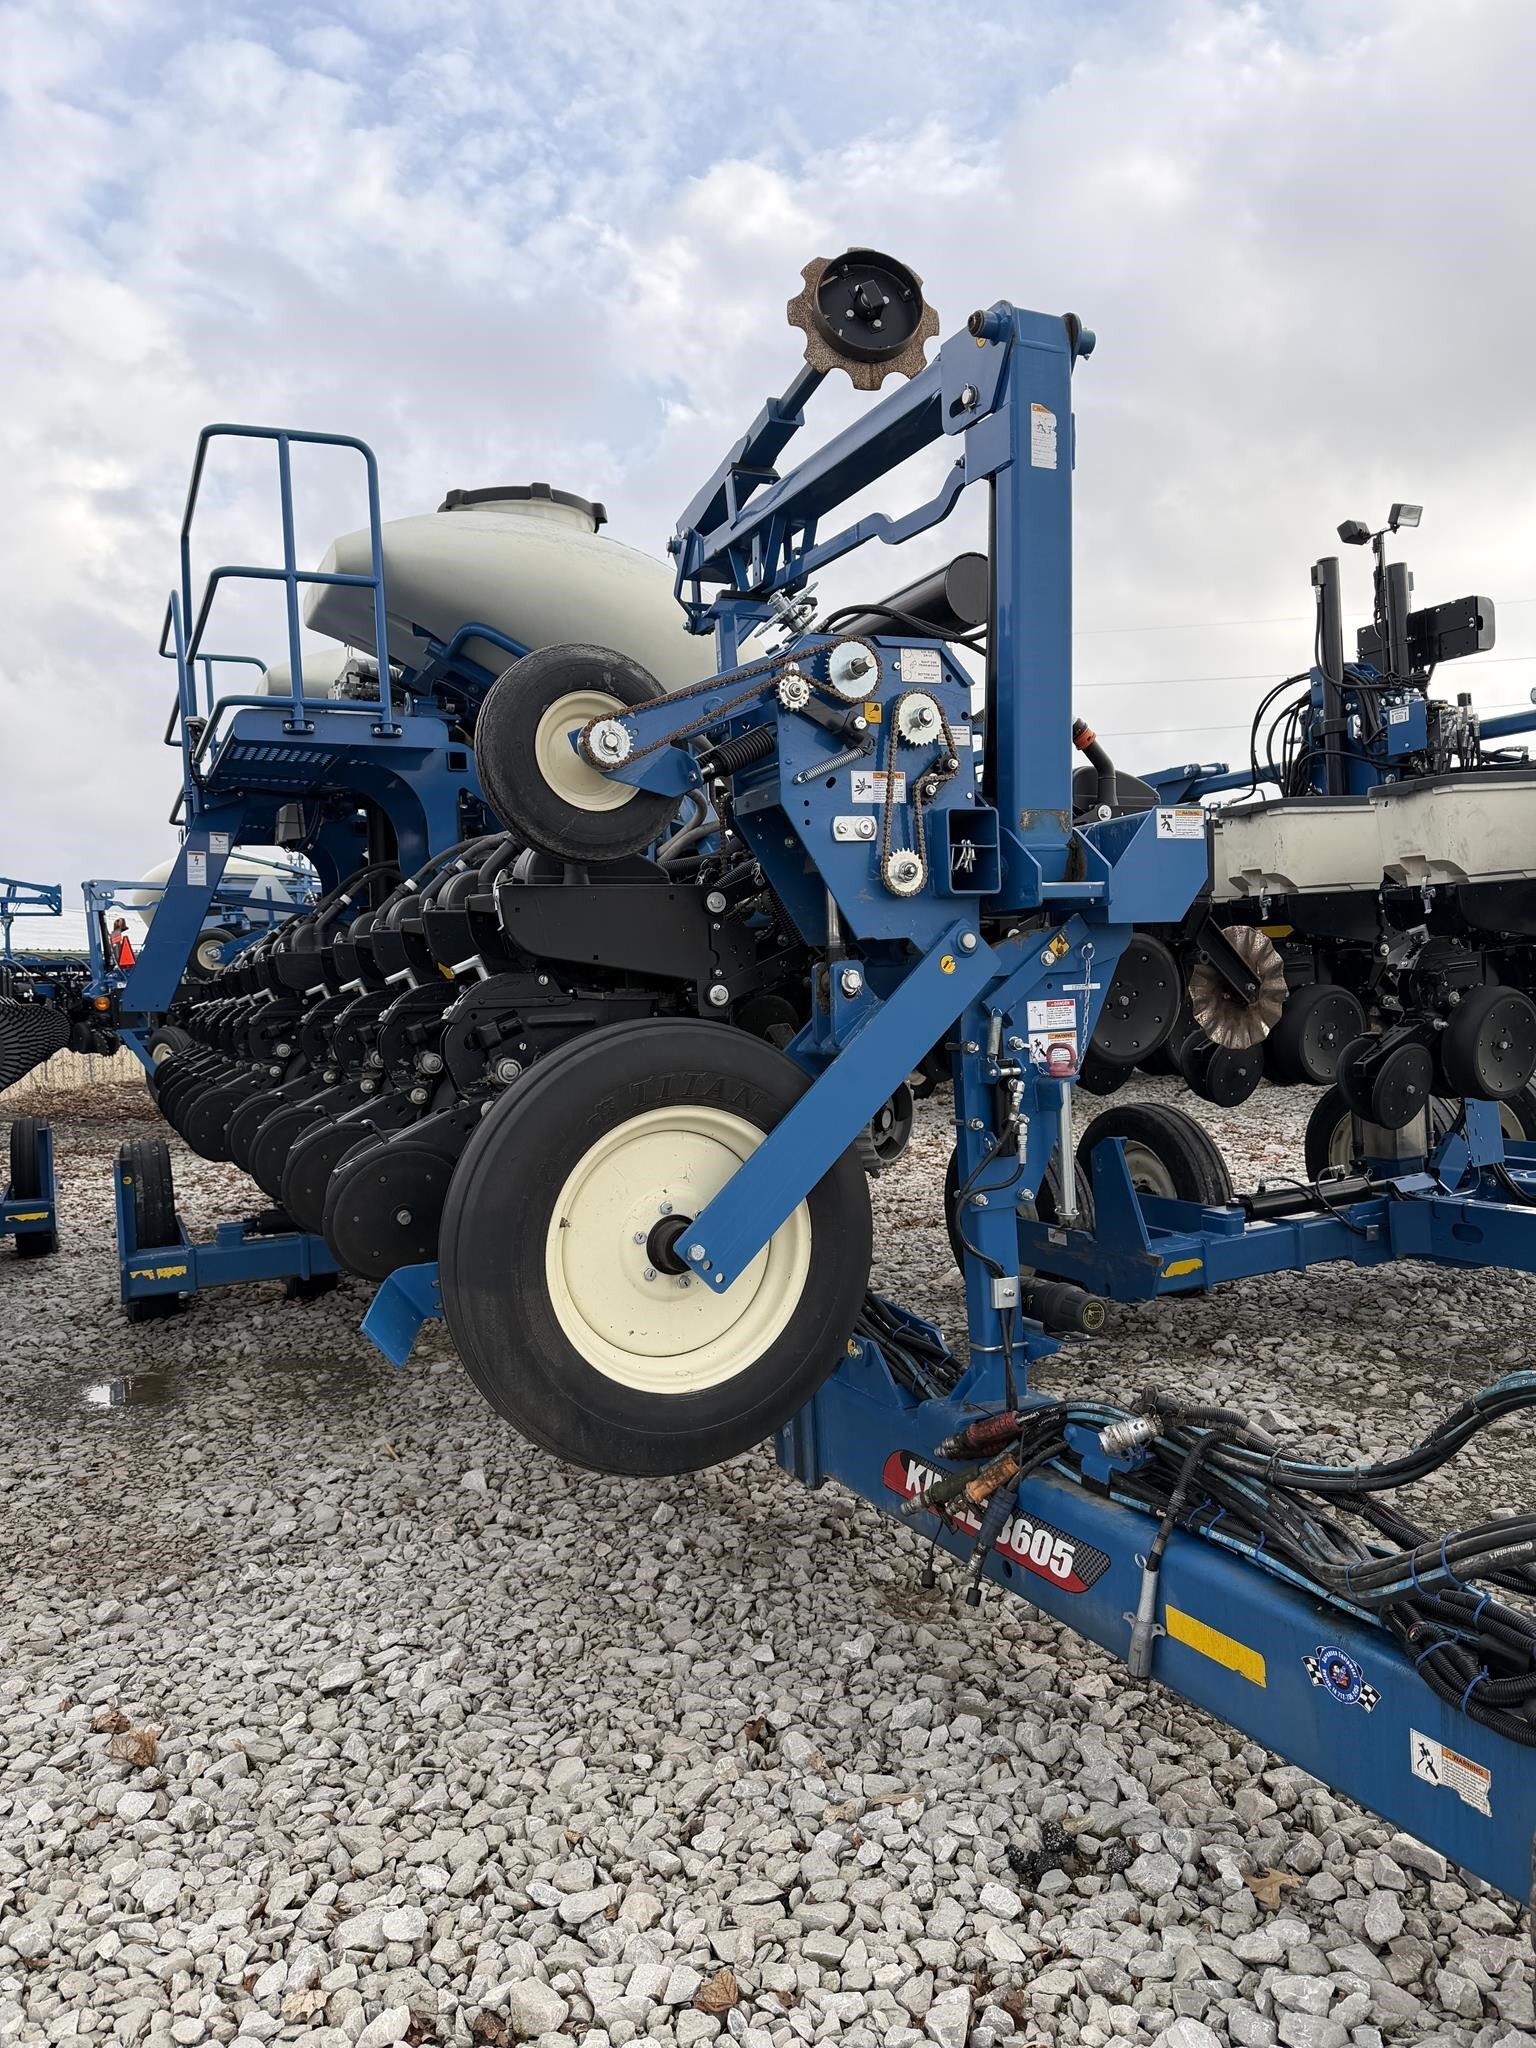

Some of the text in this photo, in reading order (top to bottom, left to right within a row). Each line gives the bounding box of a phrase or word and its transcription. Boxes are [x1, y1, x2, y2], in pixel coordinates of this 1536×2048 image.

[630, 1071, 763, 1110] TITAN
[996, 1514, 1076, 1579] 3605
[1452, 1754, 1484, 1776] WARNING
